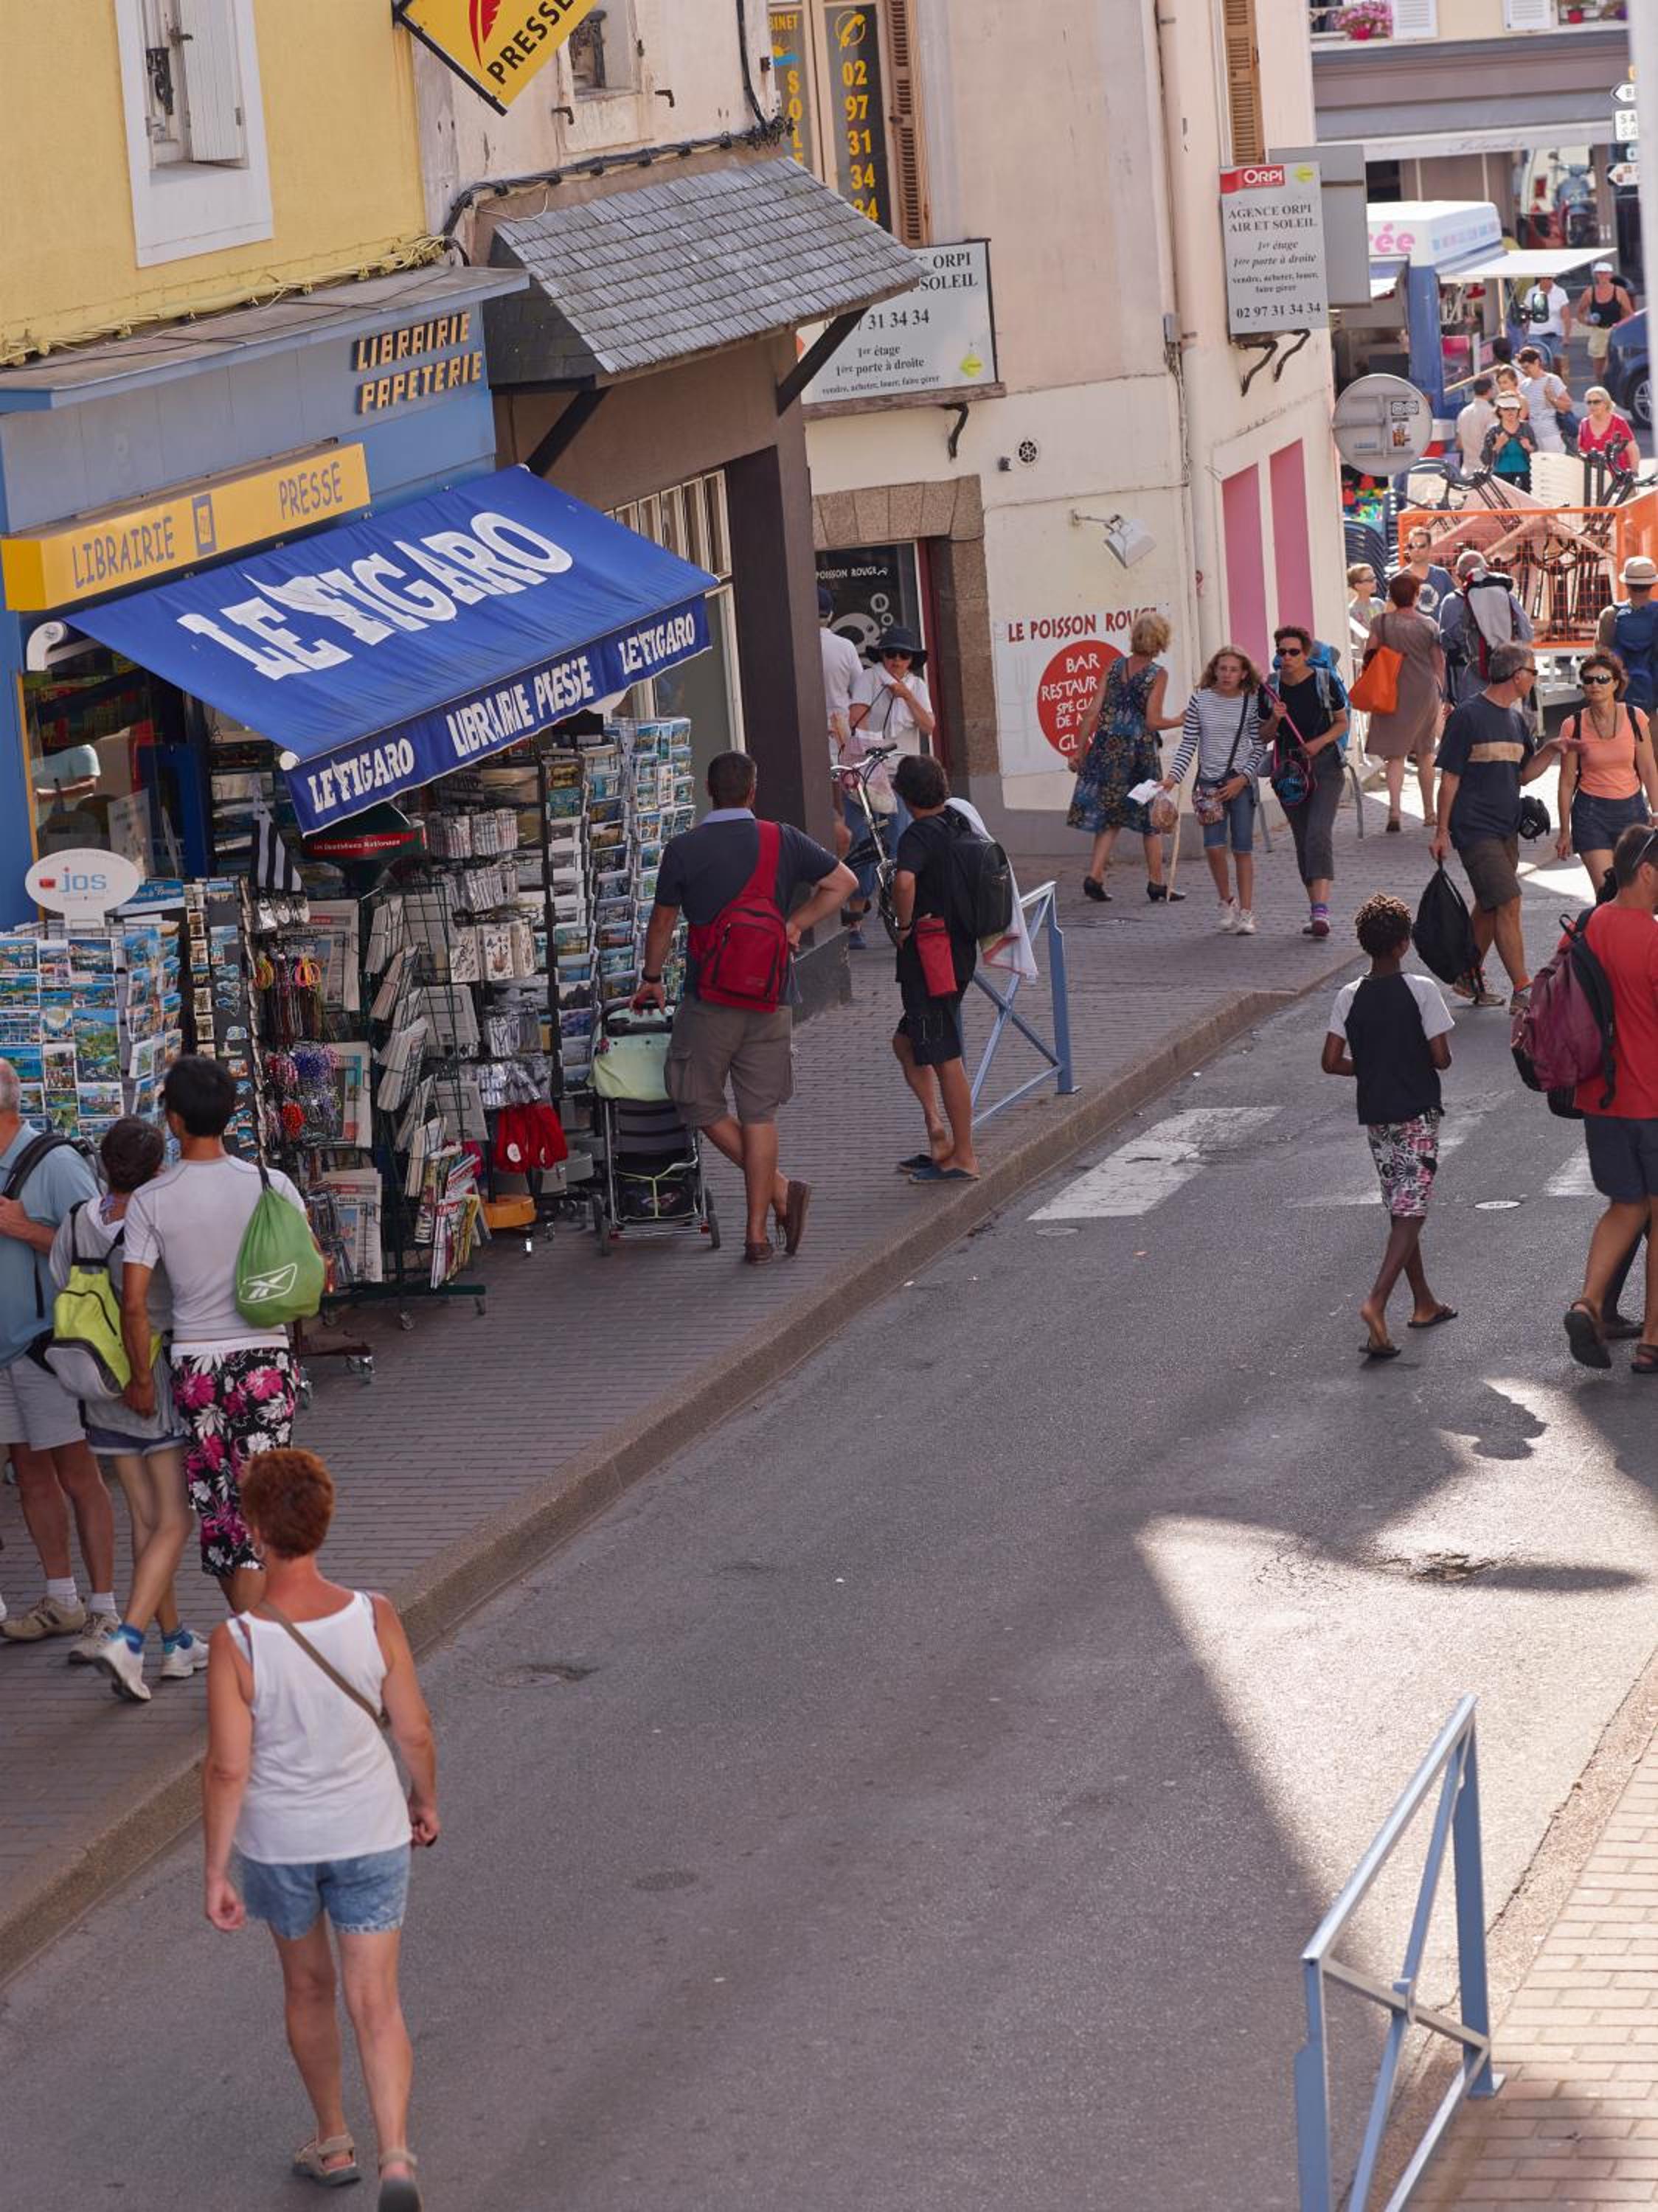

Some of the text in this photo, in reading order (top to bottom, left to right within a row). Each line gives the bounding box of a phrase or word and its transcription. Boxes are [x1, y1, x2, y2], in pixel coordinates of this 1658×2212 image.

[842, 60, 868, 87] 02
[844, 94, 869, 122] 97
[847, 129, 872, 156] 31
[850, 162, 875, 190] 34
[1244, 169, 1283, 184] ORPI
[1228, 204, 1311, 219] AGENCE ORPI
[1229, 218, 1318, 233] AIR ET SOLEIL
[1369, 223, 1416, 253] ée
[933, 251, 971, 269] ORPI
[920, 273, 979, 291] SOLEIL
[867, 308, 929, 330] 31 34 34
[1236, 302, 1321, 319] 02 97 31 34 34
[357, 313, 471, 372] LIBRAIRIE
[856, 363, 883, 377] porte
[894, 358, 925, 370] droite
[361, 350, 482, 414] PAPETERIE
[72, 460, 344, 589] LIBRAIRIE PRESSE
[1007, 607, 1157, 643] LE POISSON ROU
[1065, 653, 1101, 674] BAR
[445, 684, 535, 758] LIBRAIRIE
[1055, 715, 1073, 729] DE
[58, 866, 107, 893] jos
